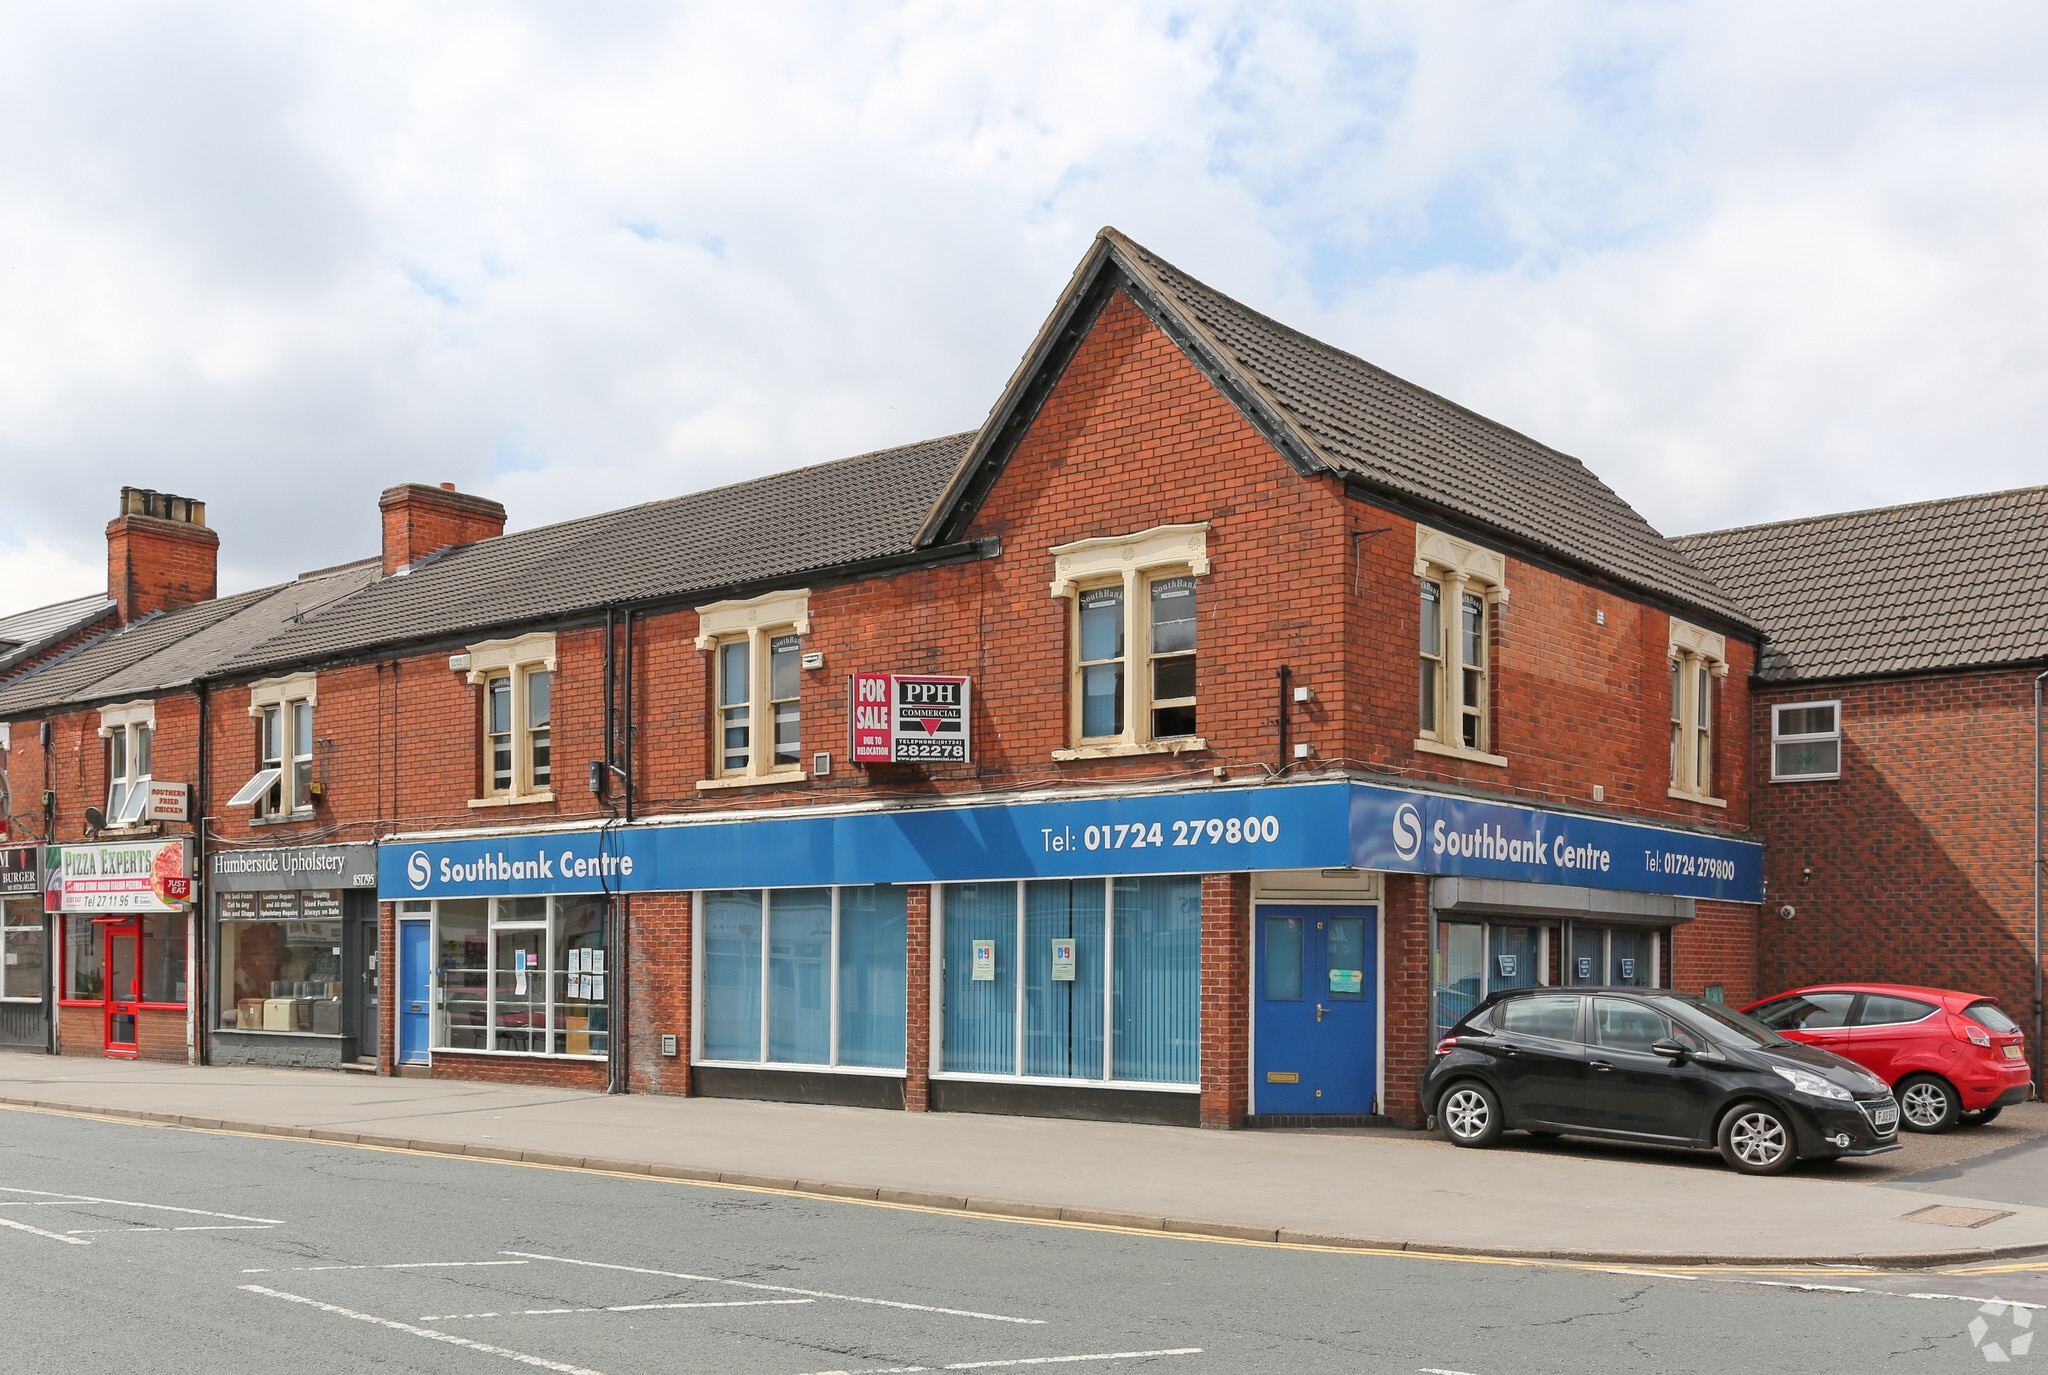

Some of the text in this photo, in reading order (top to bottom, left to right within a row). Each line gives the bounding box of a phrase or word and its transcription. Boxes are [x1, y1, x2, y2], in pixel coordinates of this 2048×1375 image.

[1152, 579, 1196, 596] SouthBank
[1080, 589, 1124, 606] SouthBank
[772, 636, 800, 650] SouthBan
[859, 679, 886, 702] FOR
[905, 684, 955, 703] PPH
[856, 706, 888, 730] SALE
[863, 736, 882, 744] DUE TO
[857, 746, 888, 756] RELOCATION
[897, 745, 964, 756] 282278
[1041, 815, 1280, 852] Tel: 01724 279800
[1433, 819, 1611, 872] Southbank Centre
[65, 848, 152, 876] PIZZA EXPERTS
[214, 852, 345, 876] Humberside Upholstery
[440, 850, 633, 883] Southbank Centre
[1645, 850, 1735, 881] Tel: 01724 279800
[2, 871, 35, 883] BURGER
[353, 874, 374, 887] 851795
[84, 895, 129, 907] Tel 27 11 96
